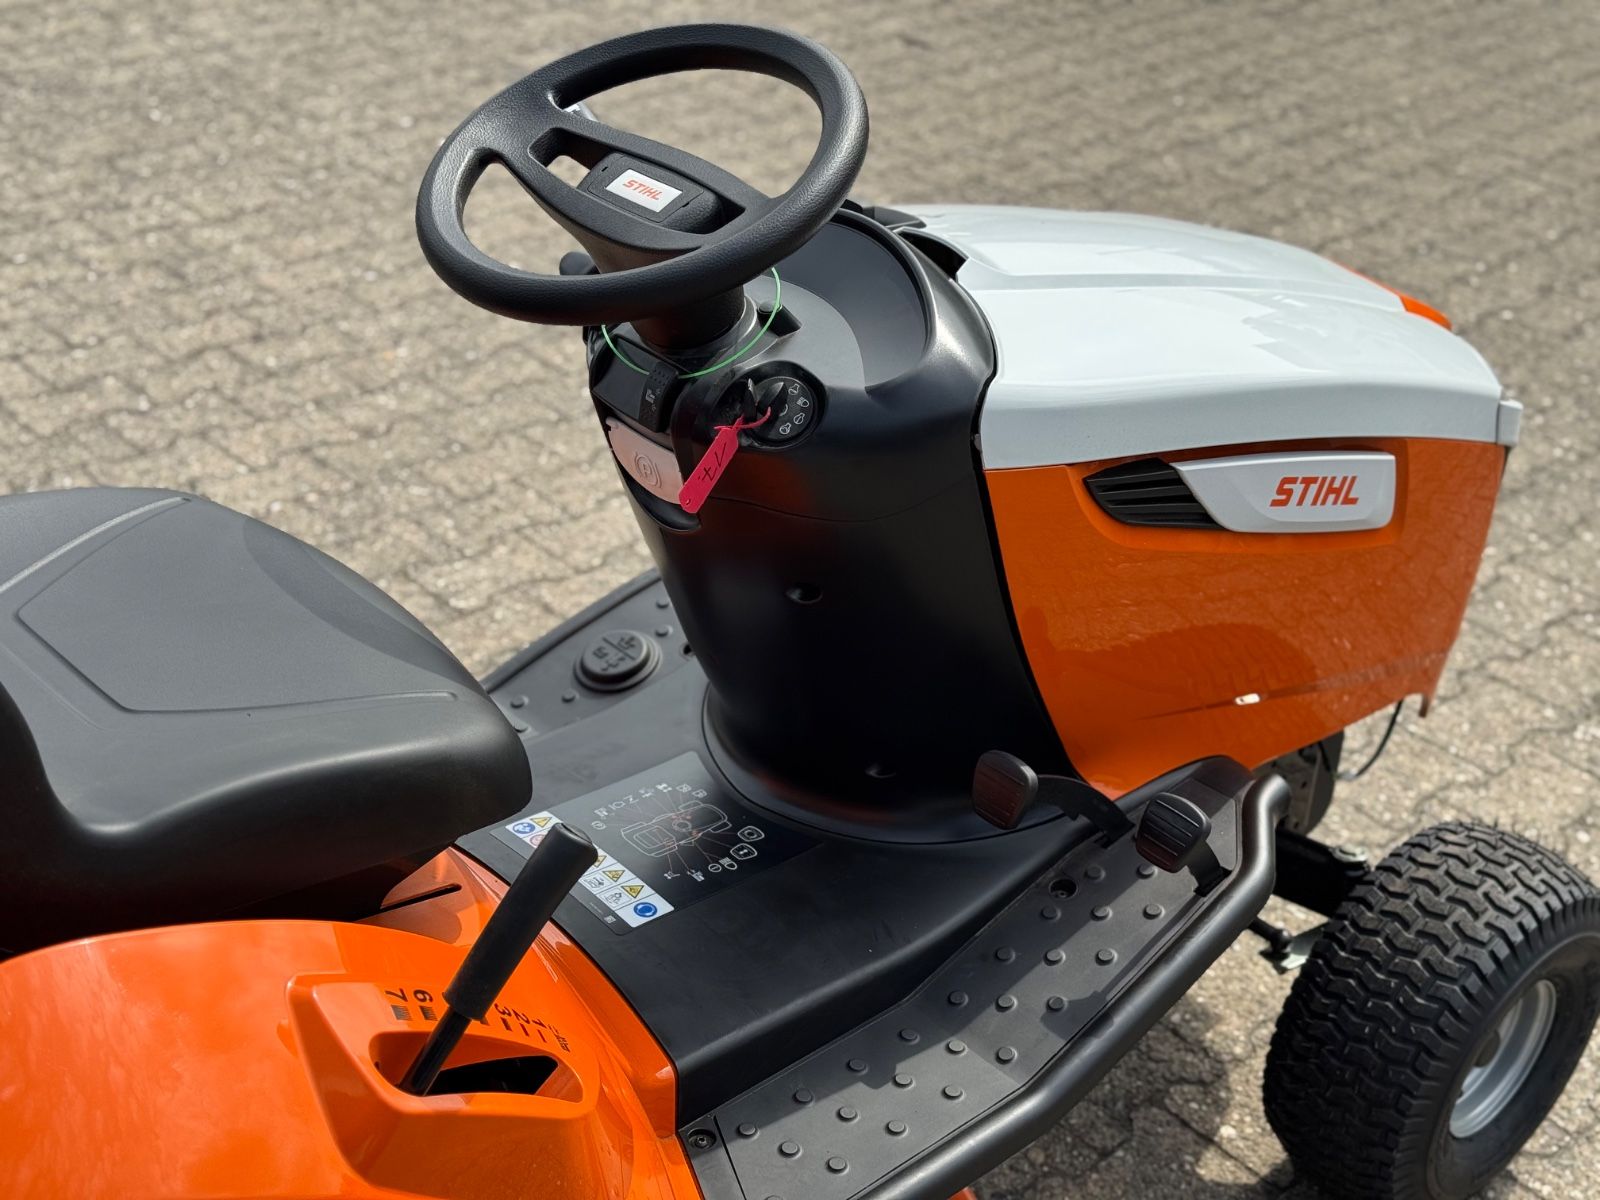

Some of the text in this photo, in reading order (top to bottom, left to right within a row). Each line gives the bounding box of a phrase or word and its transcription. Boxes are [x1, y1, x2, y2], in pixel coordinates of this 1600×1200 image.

[622, 179, 663, 201] STIHL
[1269, 475, 1359, 508] STIHL
[385, 988, 548, 1029] 7 6 3 2 1
